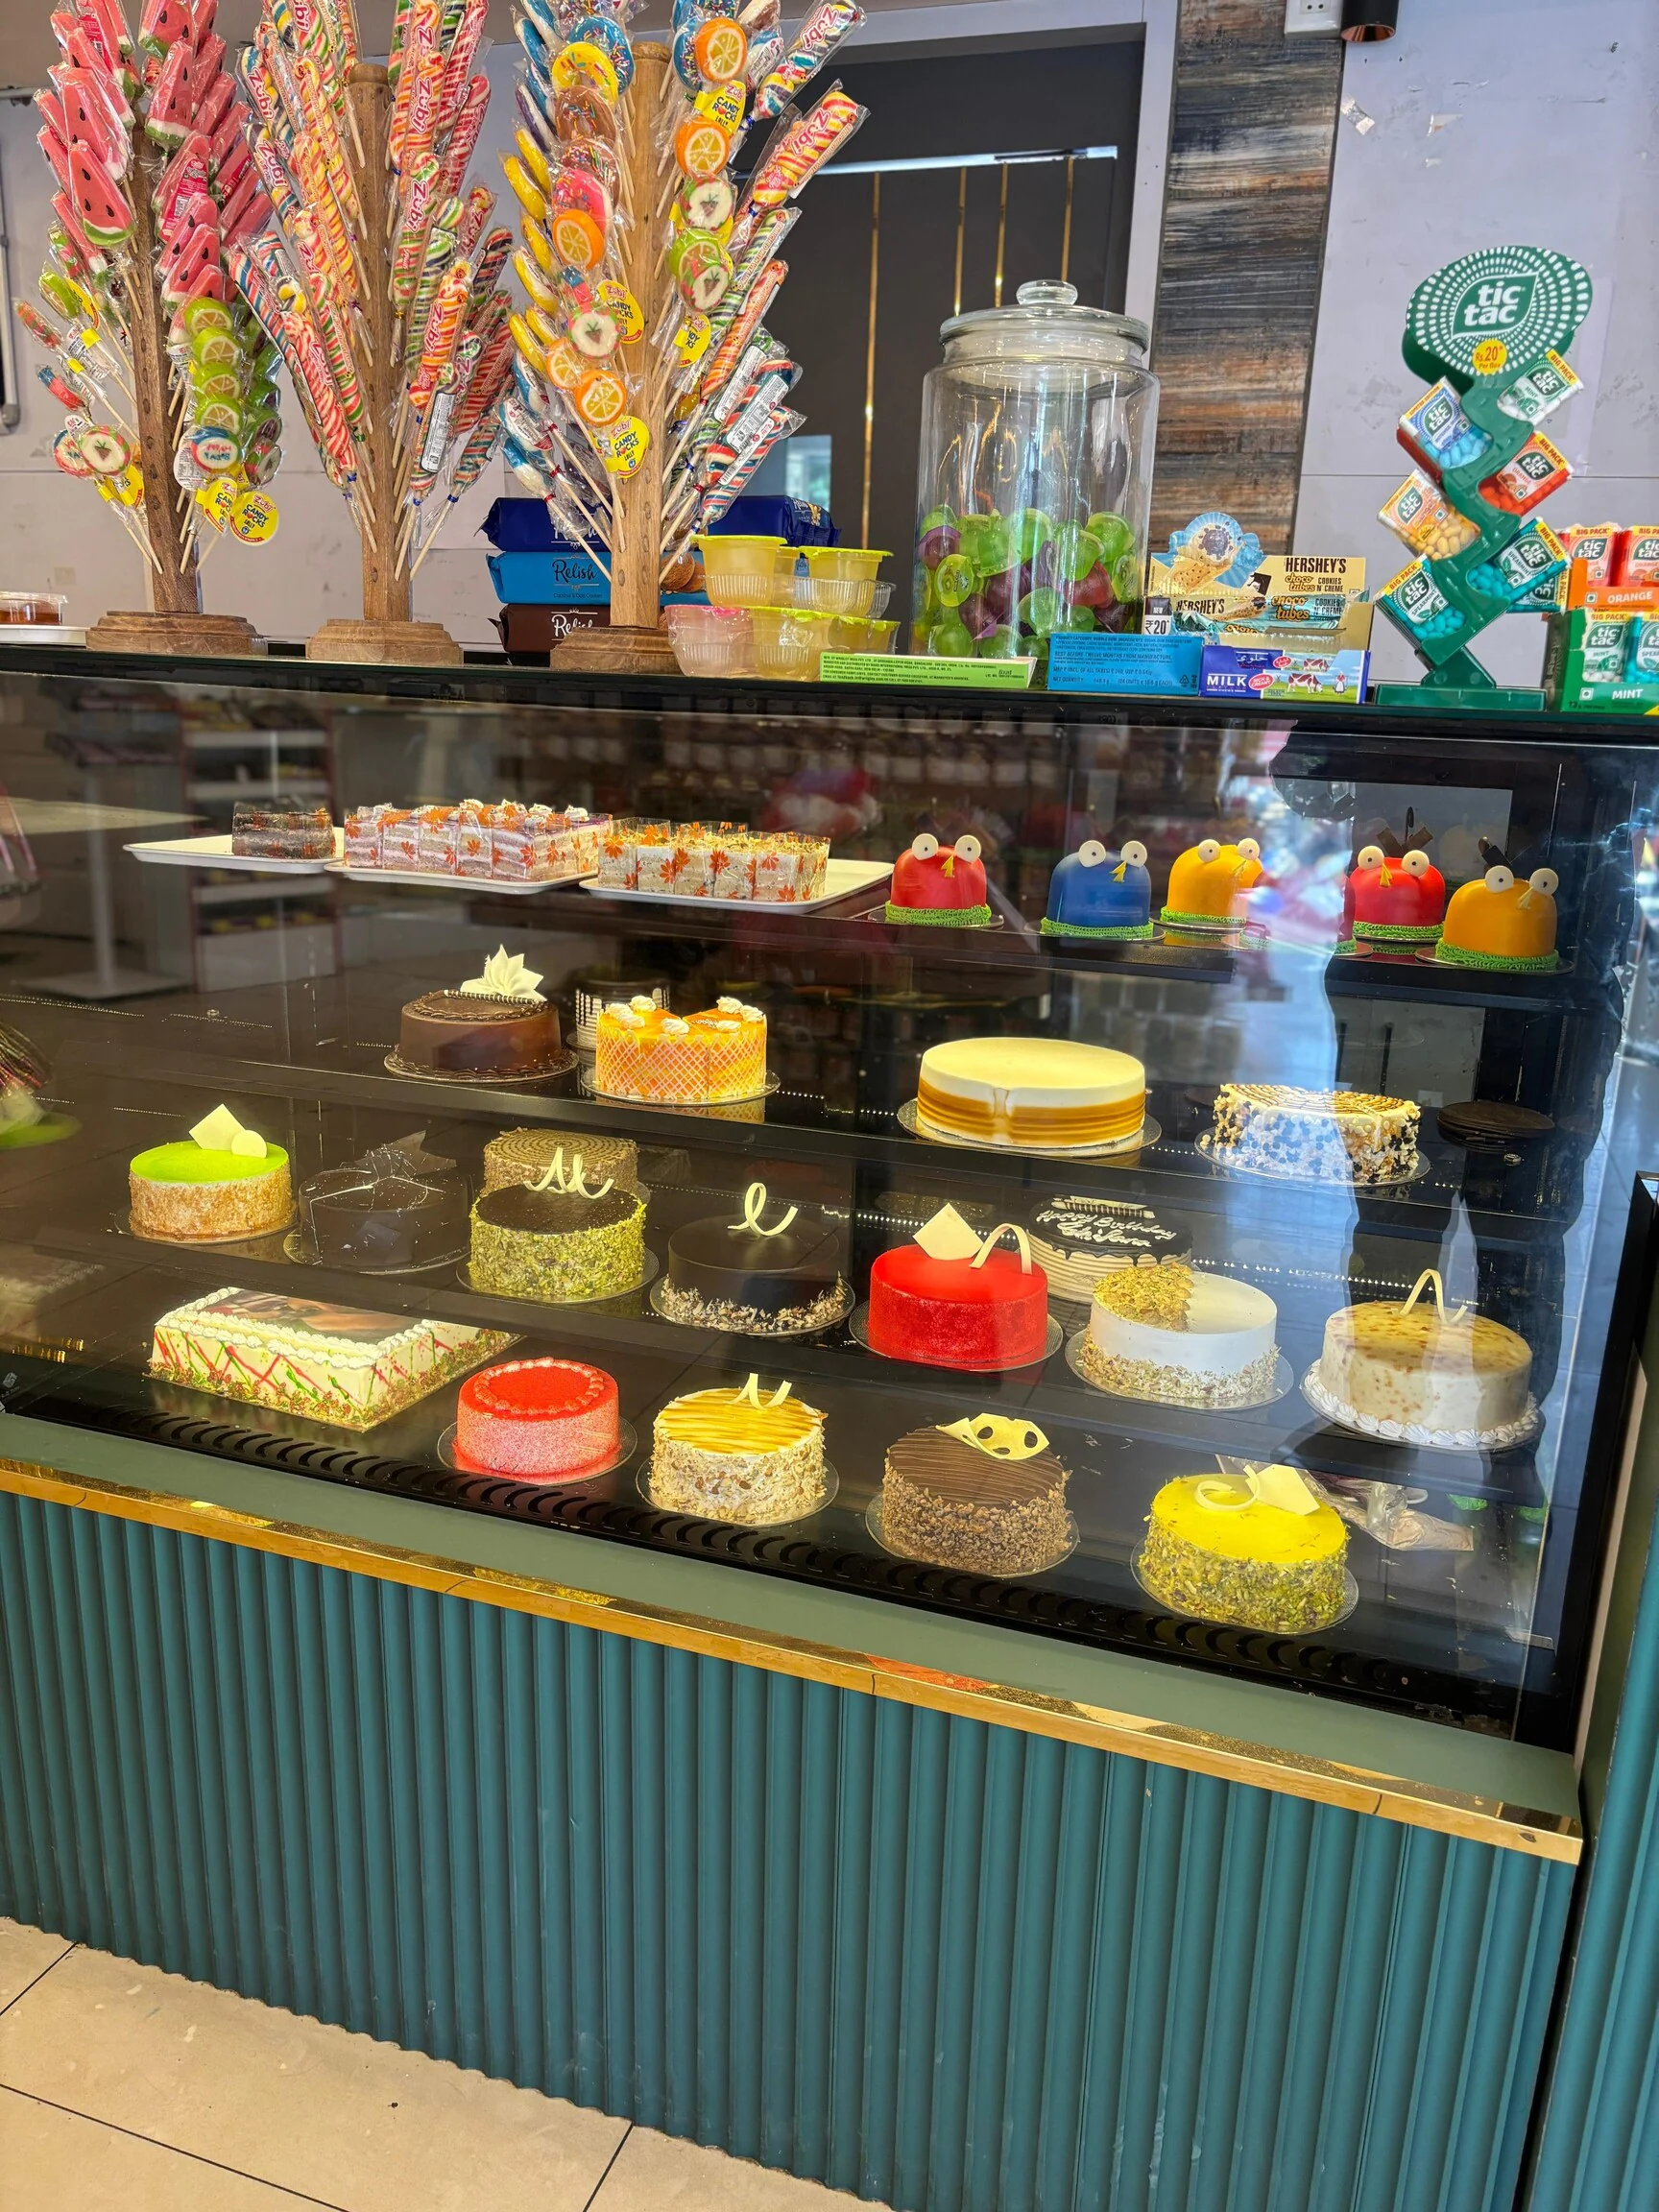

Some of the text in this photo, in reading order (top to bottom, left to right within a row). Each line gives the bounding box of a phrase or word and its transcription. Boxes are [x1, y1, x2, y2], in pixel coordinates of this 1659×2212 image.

[803, 5, 839, 49] Zubi
[249, 69, 273, 116] Zubi
[413, 79, 431, 131] Zubi
[716, 97, 740, 113] CANDY
[793, 110, 830, 154] Zubi
[258, 141, 287, 184] Zubi
[408, 183, 427, 229] Zubi
[299, 242, 317, 274] Zu
[1479, 280, 1522, 306] tic
[1464, 303, 1518, 326] tac
[425, 303, 444, 350] Zubi
[1551, 353, 1562, 366] BIG
[1532, 373, 1551, 394] tac
[1542, 370, 1559, 389] tic
[1429, 401, 1446, 421] tic
[611, 420, 631, 438] Zubi
[1429, 412, 1451, 431] tac
[614, 431, 637, 451] CANDY
[1539, 438, 1565, 466] BIG PACK
[1522, 456, 1541, 479] tac
[1532, 455, 1549, 474] tic
[253, 494, 275, 513] Zubi
[1401, 491, 1417, 510] tic
[1402, 498, 1422, 518] tac
[246, 504, 269, 521] CANDY
[1539, 526, 1564, 557] BIG PACK
[1583, 539, 1602, 550] tic
[1521, 543, 1539, 567] tac
[1530, 542, 1547, 563] tic
[1577, 547, 1599, 558] tac
[552, 559, 597, 584] Relish
[1285, 557, 1346, 574] HERSHEY'S
[1508, 550, 1532, 577] SPEARMINT
[1285, 573, 1313, 584] choco
[1389, 563, 1417, 590] BIG PACK
[1405, 576, 1424, 596] tic
[1288, 582, 1315, 592] tubes
[1405, 585, 1428, 606] tac
[1607, 590, 1653, 604] ORANGE
[1176, 598, 1225, 614] HERSHEY'S
[1271, 595, 1308, 607] choco
[1314, 598, 1341, 607] COOKIES
[1321, 606, 1343, 615] CREME
[1411, 589, 1437, 616] SPEARMINT
[1276, 606, 1310, 621] tubes
[1590, 636, 1615, 645] tac
[1597, 626, 1617, 637] tic
[1207, 675, 1247, 686] MILK
[1612, 688, 1644, 700] MINT
[1036, 1210, 1097, 1223] Happy
[1094, 1215, 1177, 1240] Birthday
